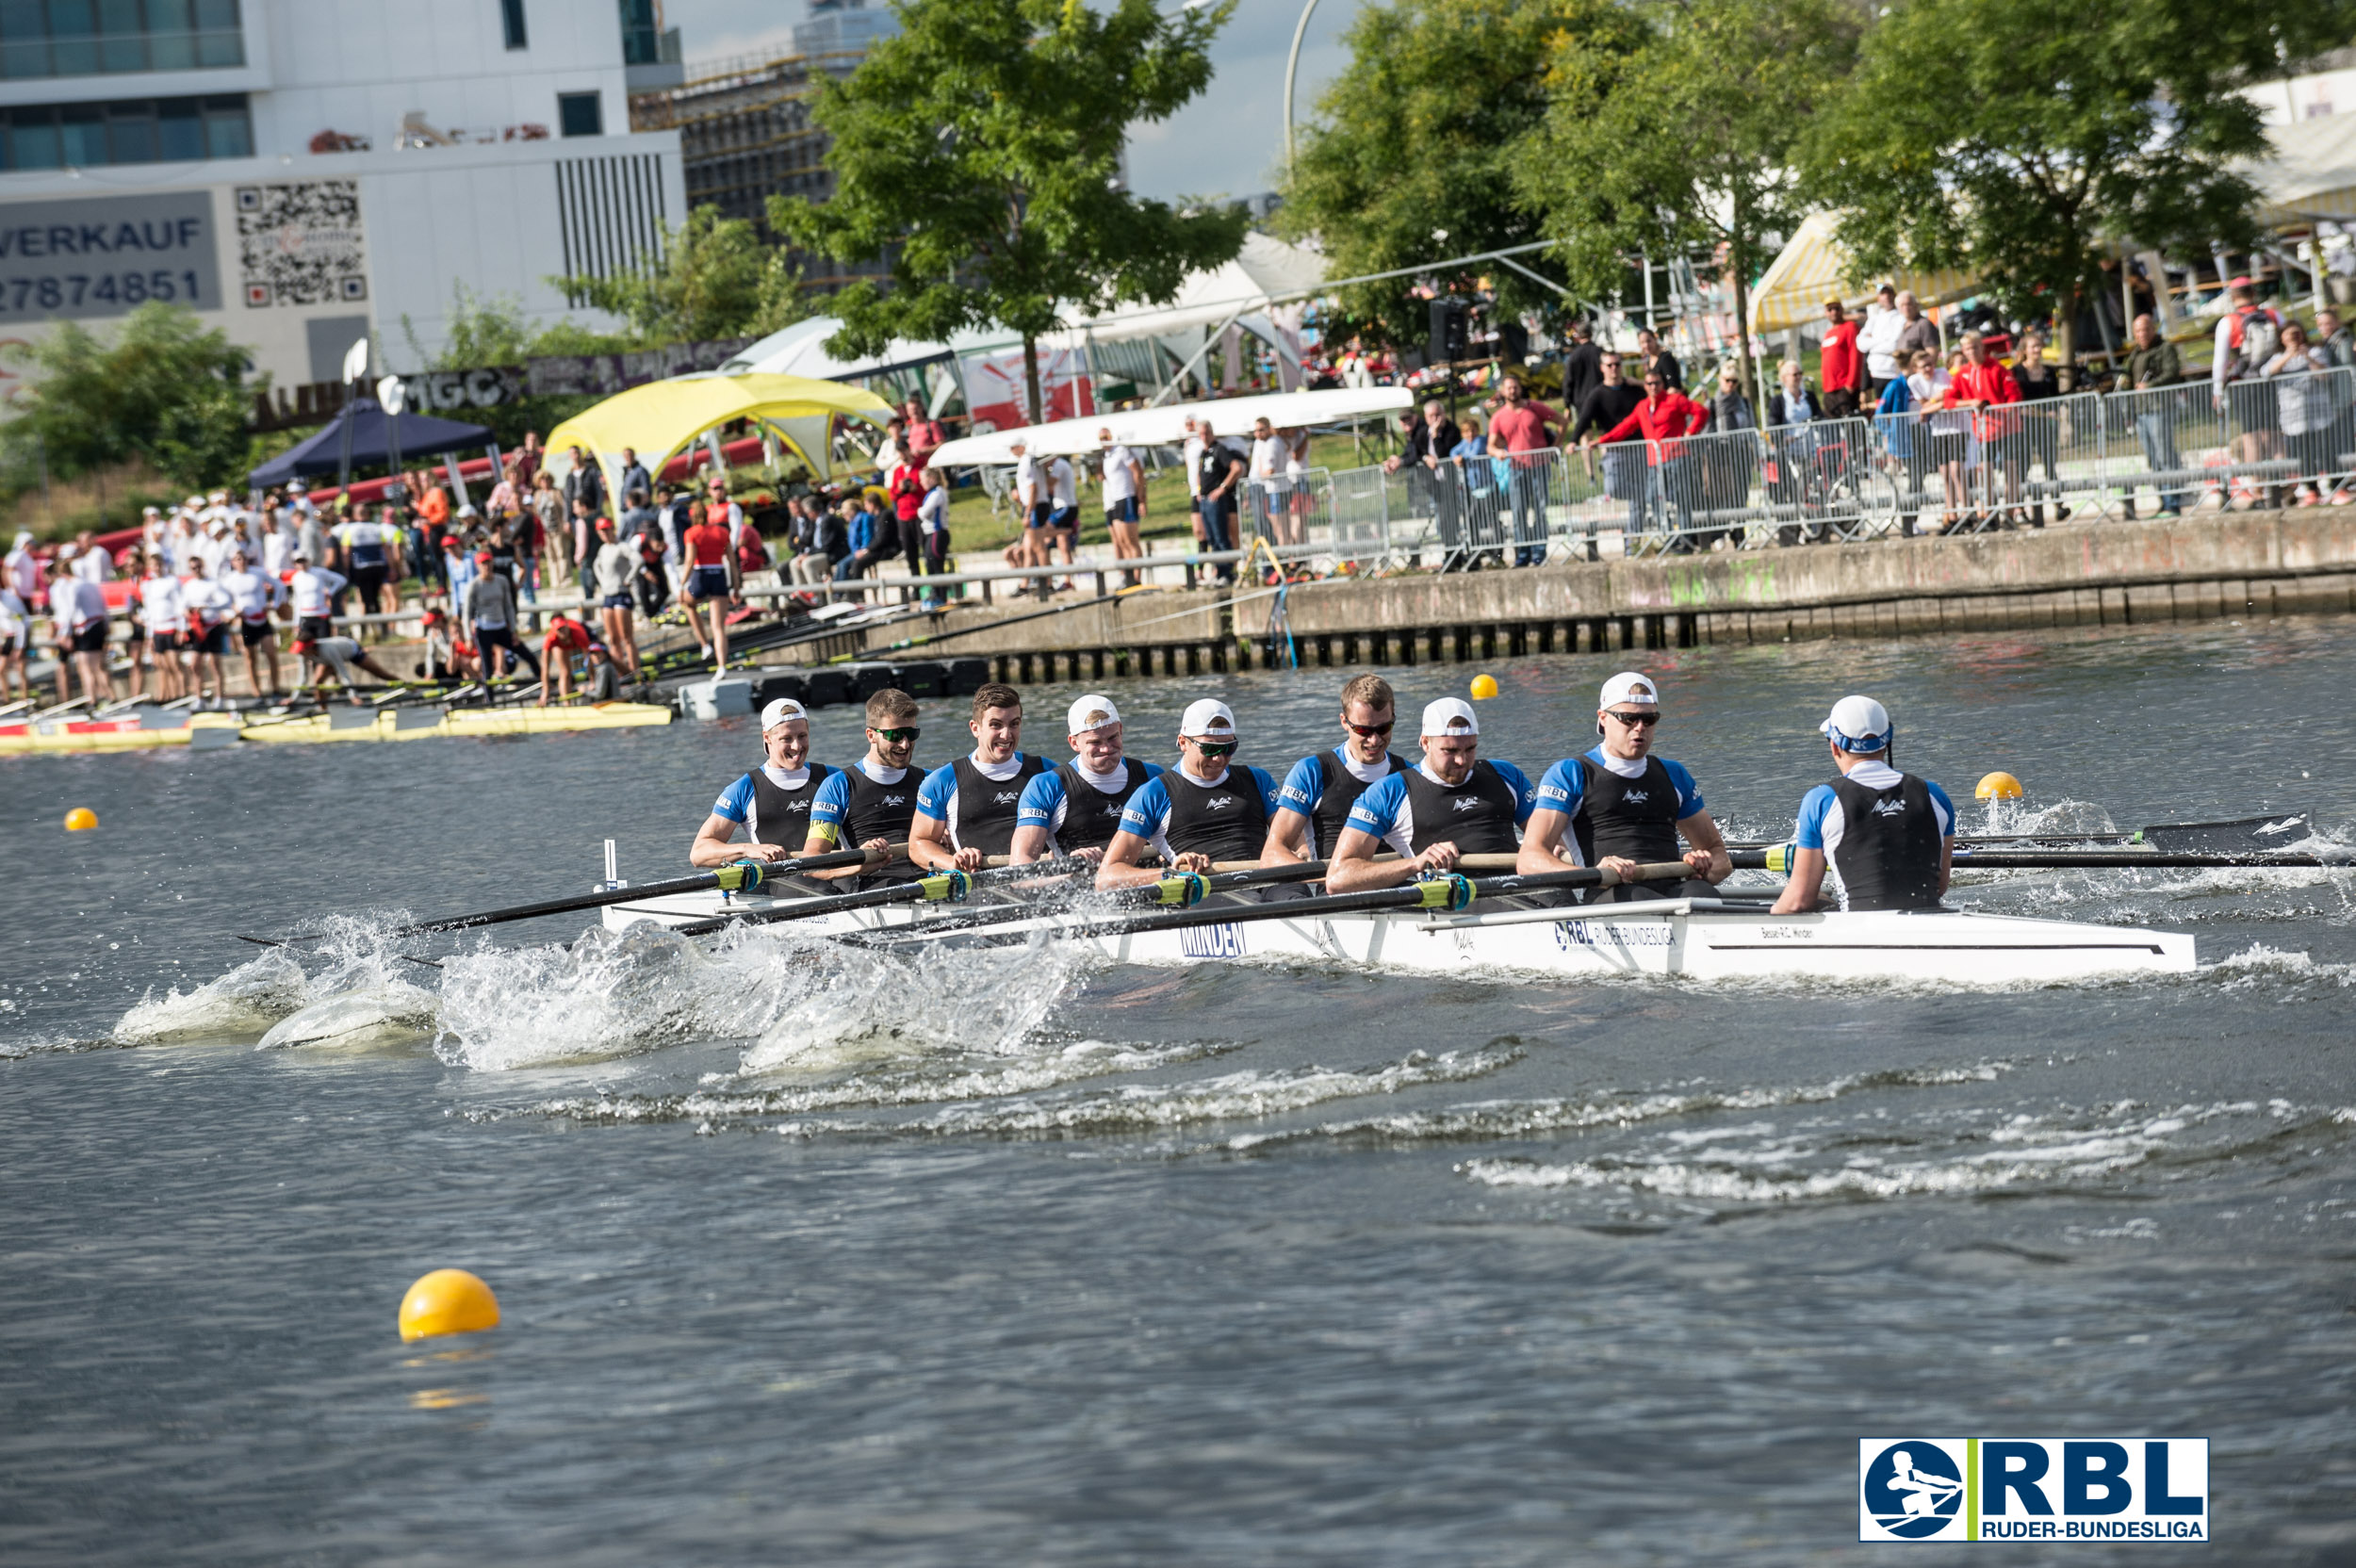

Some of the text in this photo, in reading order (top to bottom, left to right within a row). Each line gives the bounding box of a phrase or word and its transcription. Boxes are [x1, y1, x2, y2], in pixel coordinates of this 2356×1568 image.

[0, 270, 198, 312] 7874851
[819, 802, 837, 812] RBL
[1180, 923, 1246, 956] MINDEN
[1565, 920, 1676, 946] RBL RUDER-BUNDESLIGA
